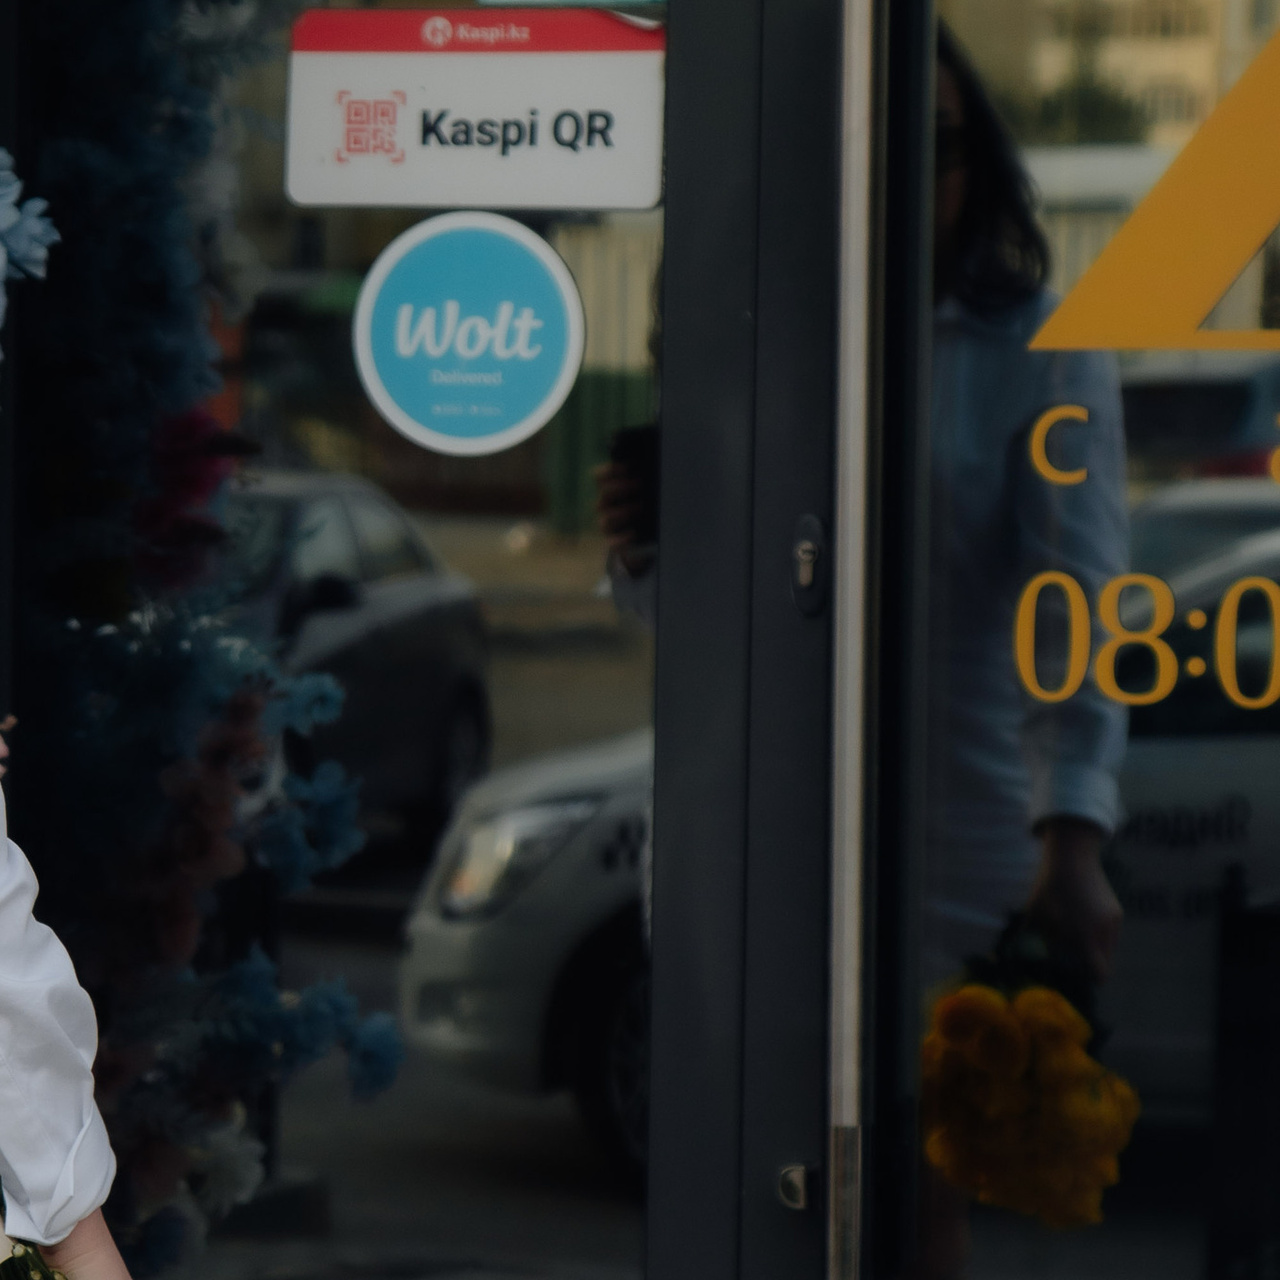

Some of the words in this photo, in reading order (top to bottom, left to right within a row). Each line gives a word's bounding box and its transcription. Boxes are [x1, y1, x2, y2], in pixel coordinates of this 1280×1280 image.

[456, 23, 530, 45] Kaspi.kz
[421, 109, 538, 156] Kaspi
[553, 110, 614, 153] QR
[394, 299, 544, 360] Wolt
